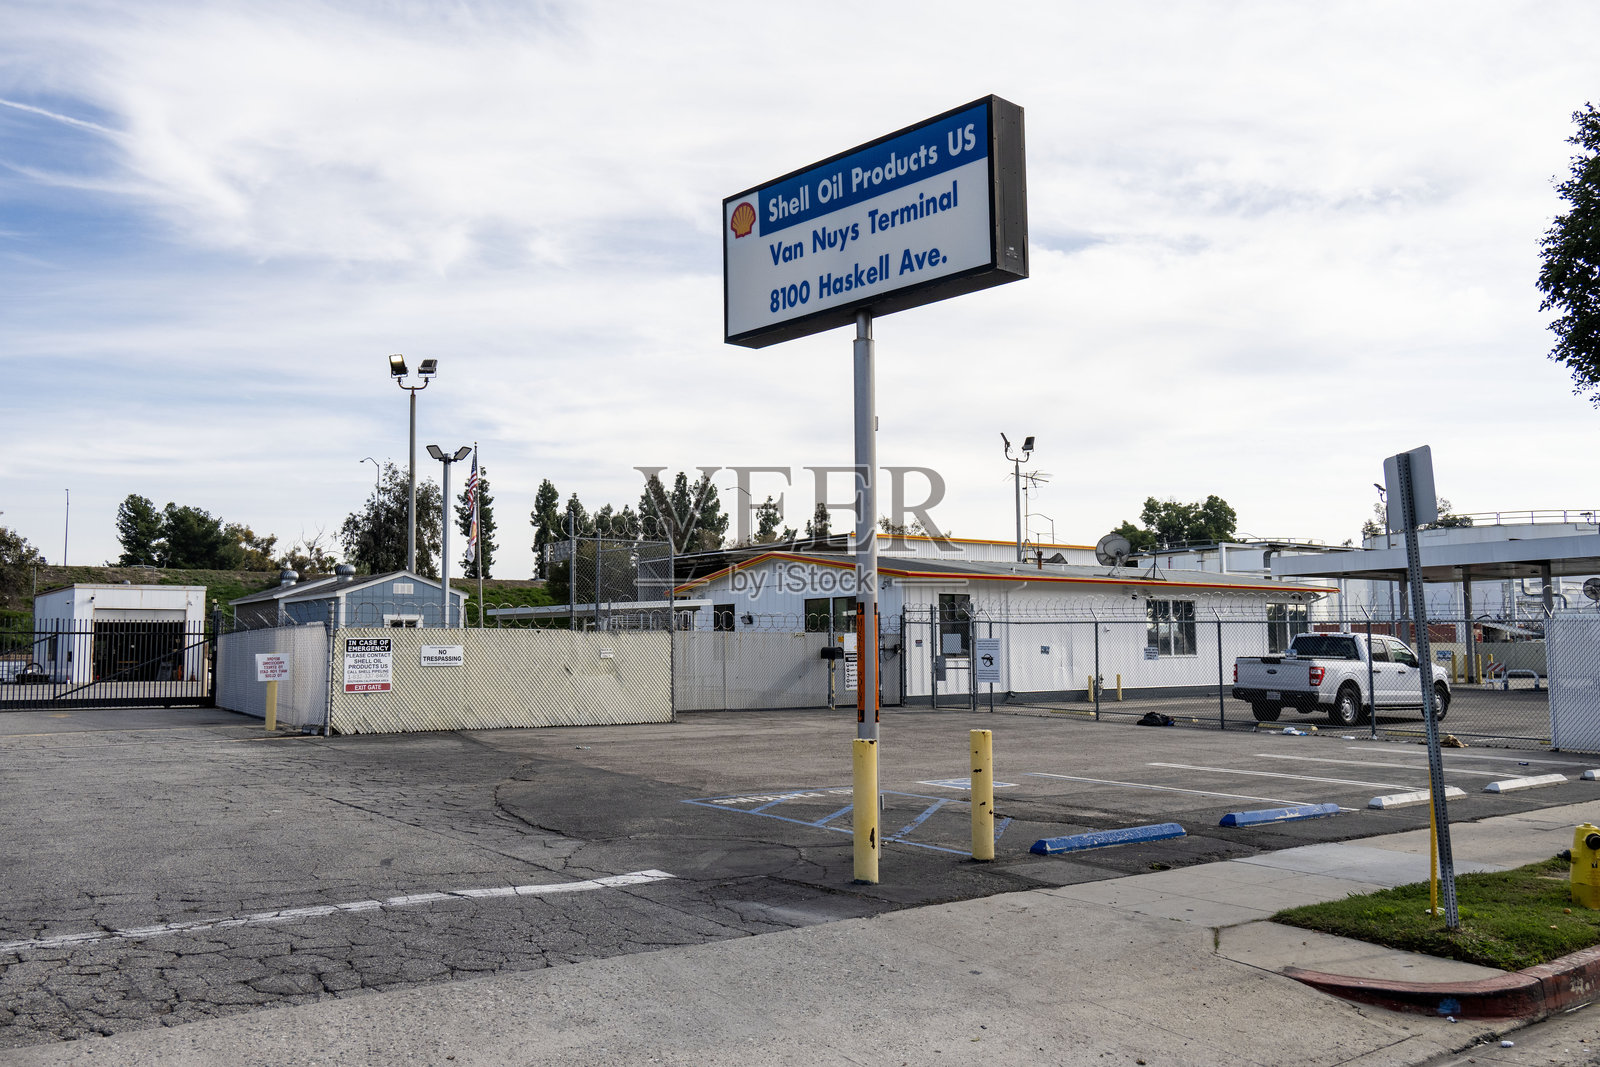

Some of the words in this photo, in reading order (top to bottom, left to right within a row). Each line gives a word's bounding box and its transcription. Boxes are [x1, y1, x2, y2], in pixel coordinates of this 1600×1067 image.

[768, 185, 810, 223] Shell
[817, 172, 843, 204] Oil
[851, 144, 938, 193] Products
[947, 122, 976, 157] US
[769, 239, 804, 266] Van
[812, 220, 860, 253] Nuys
[868, 180, 958, 234] Terminal
[769, 280, 811, 313] 8100
[818, 253, 889, 300] Haskell
[899, 248, 948, 276] Ave.
